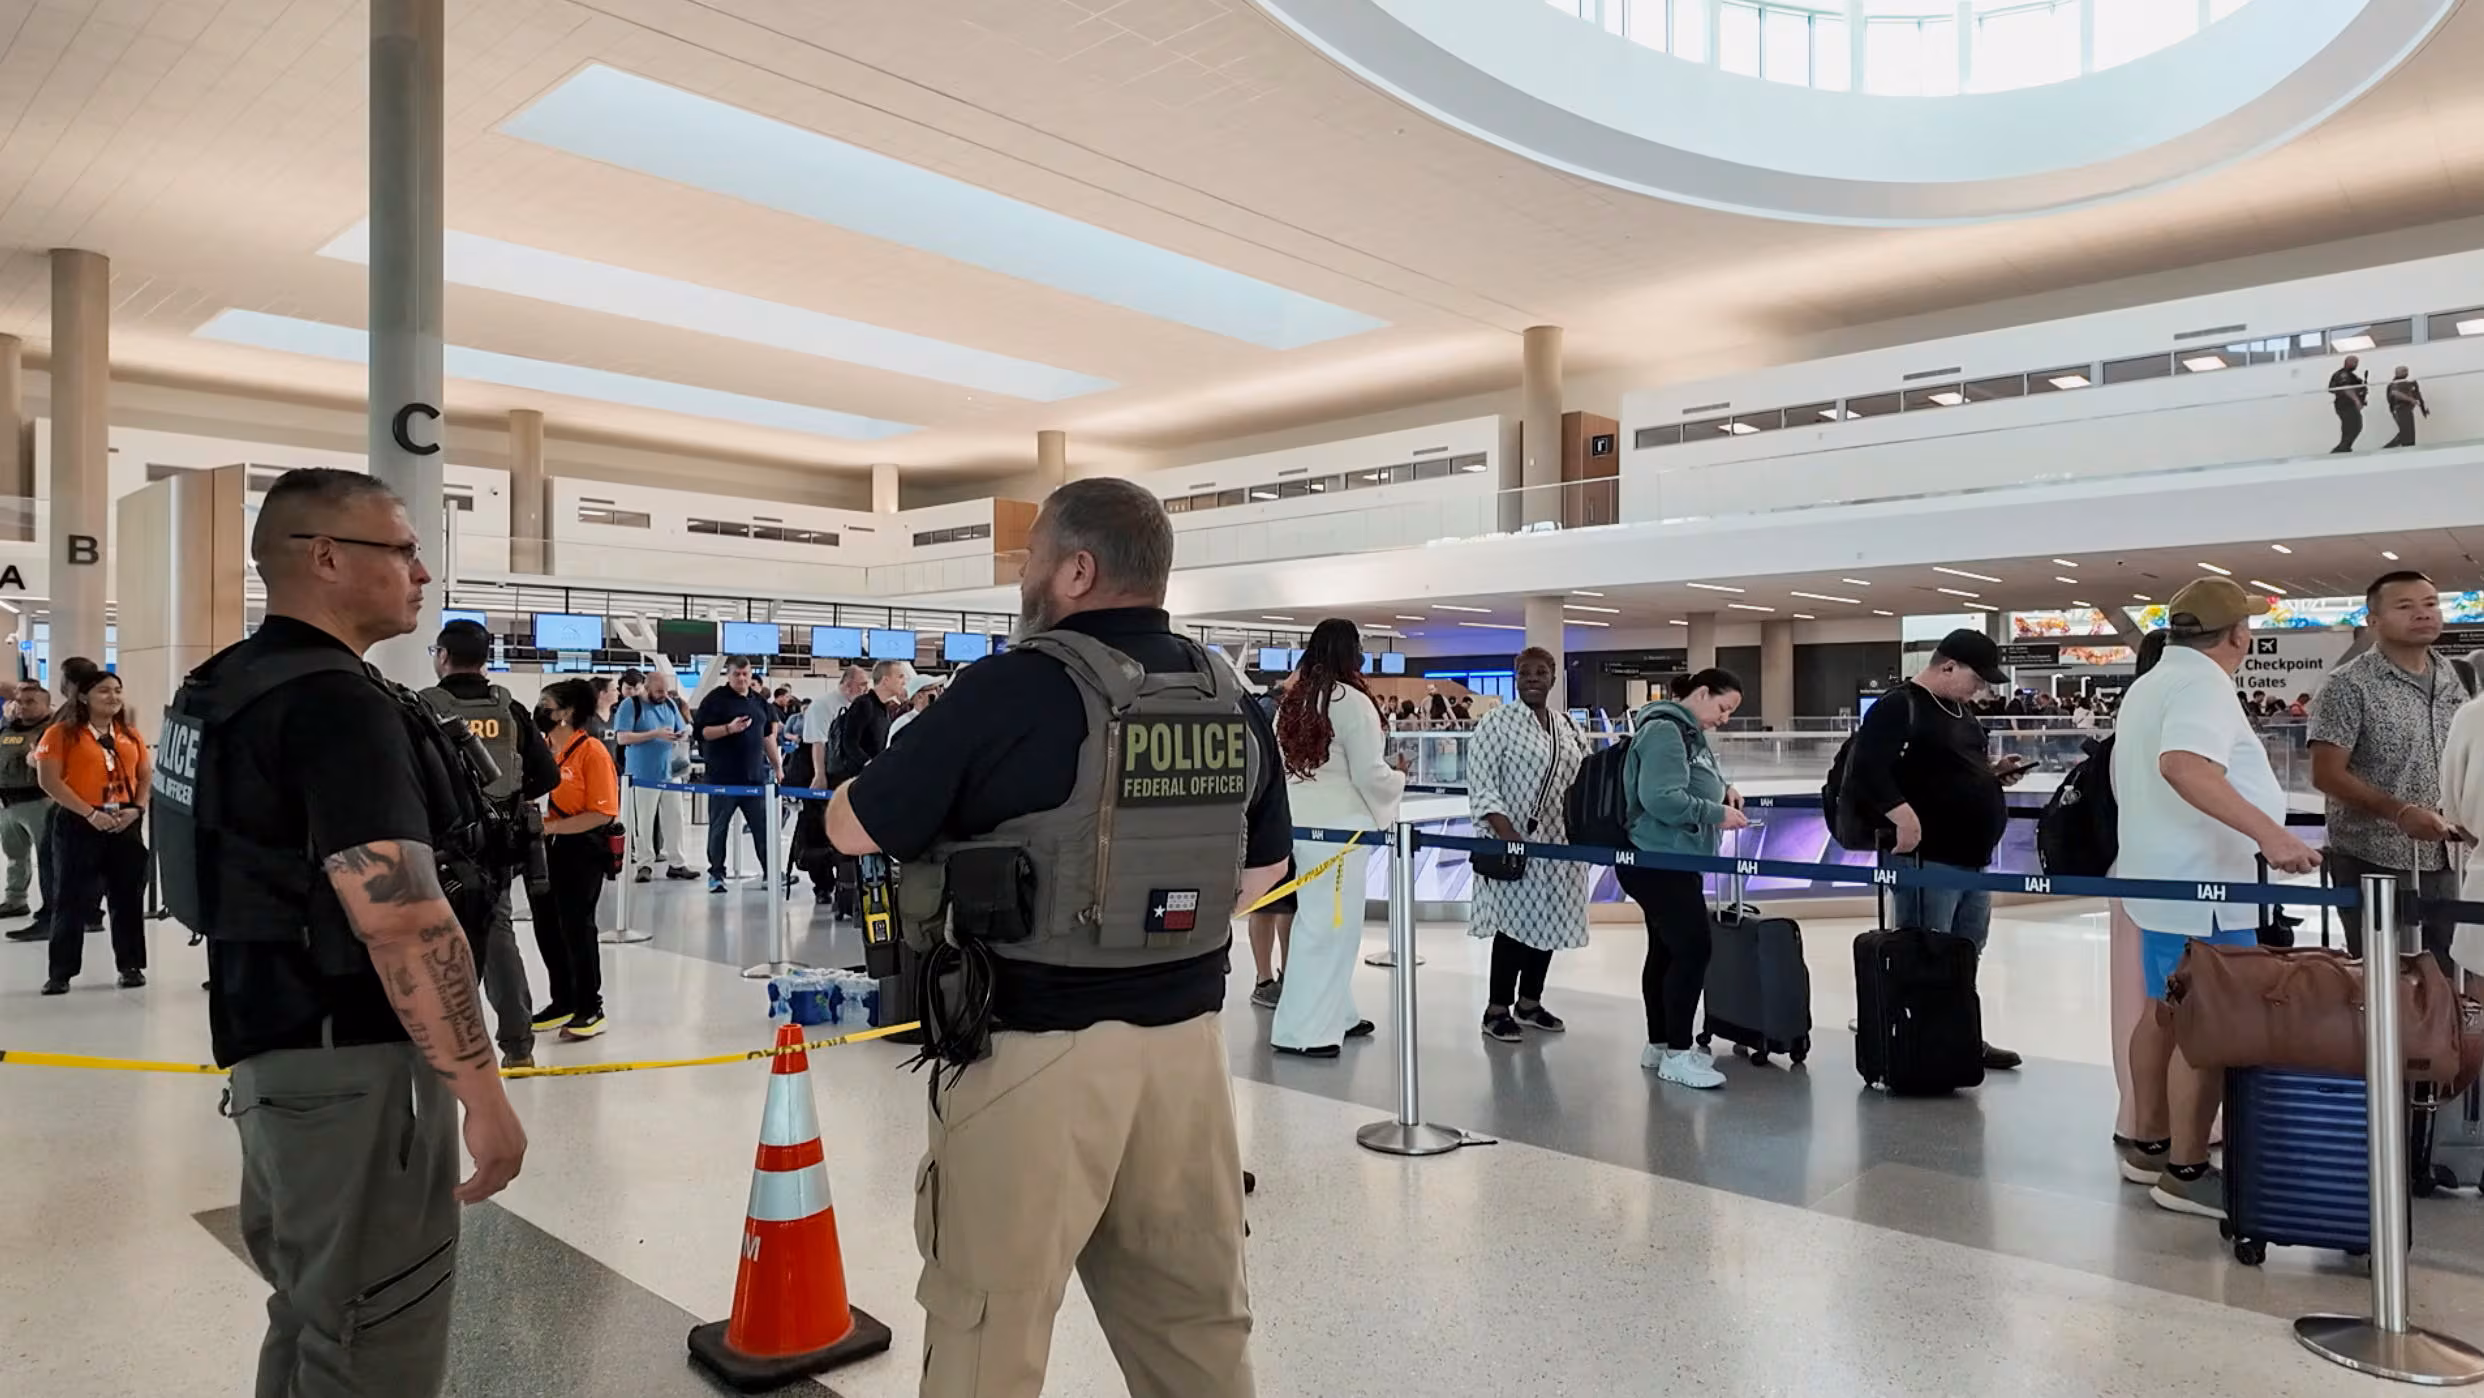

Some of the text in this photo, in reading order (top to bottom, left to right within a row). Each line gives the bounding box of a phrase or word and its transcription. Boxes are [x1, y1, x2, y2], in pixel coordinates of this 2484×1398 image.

[392, 403, 440, 456] C
[68, 534, 99, 565] B
[0, 565, 26, 590] A
[2245, 657, 2323, 673] Checkpoint
[2247, 676, 2287, 688] Gates
[467, 719, 499, 738] RO
[1125, 722, 1245, 772] POLICE
[1123, 775, 1245, 798] FEDERAL OFFICER
[1760, 798, 1774, 807] IAH
[1507, 841, 2226, 900] IAH IAH IAH IAH IAH IAH
